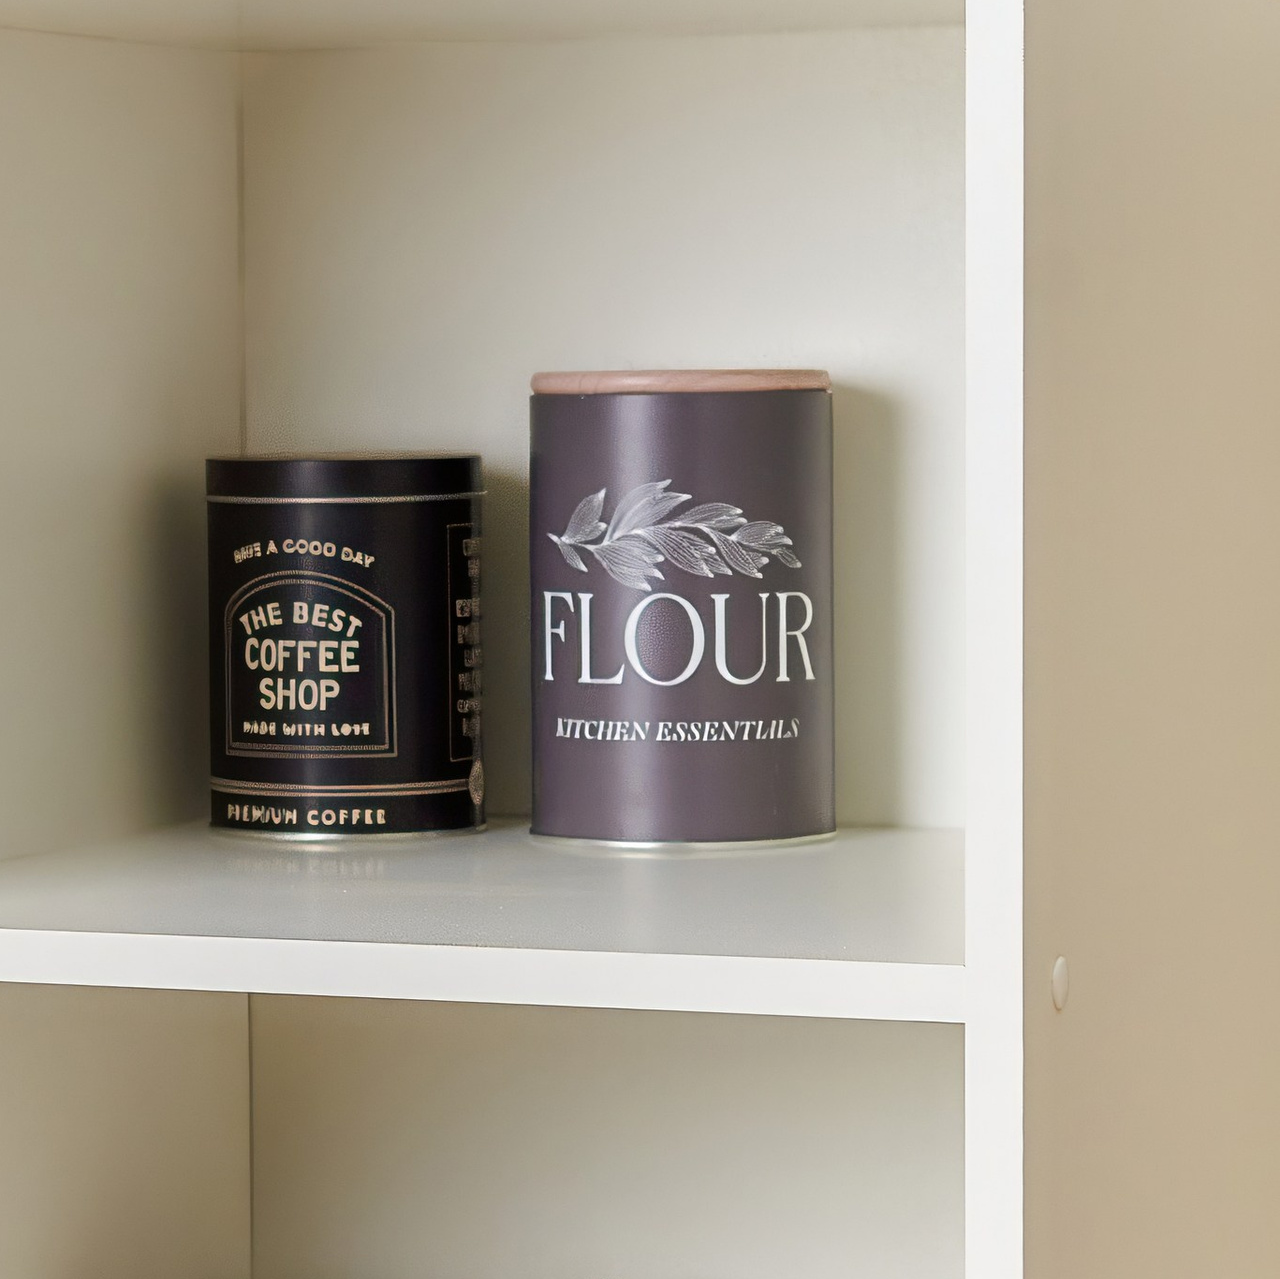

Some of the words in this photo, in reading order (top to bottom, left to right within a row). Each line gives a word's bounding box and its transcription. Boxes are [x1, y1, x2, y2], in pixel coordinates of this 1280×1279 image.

[266, 539, 279, 555] A
[340, 546, 376, 568] DAY
[239, 601, 283, 635] THE
[293, 602, 362, 637] BEST
[543, 590, 817, 688] FLOUR
[245, 638, 360, 673] COFFEE
[259, 678, 340, 711] SHOP
[283, 723, 326, 737] WITH
[556, 718, 650, 741] KITCHEN
[307, 808, 386, 826] COFFEE
